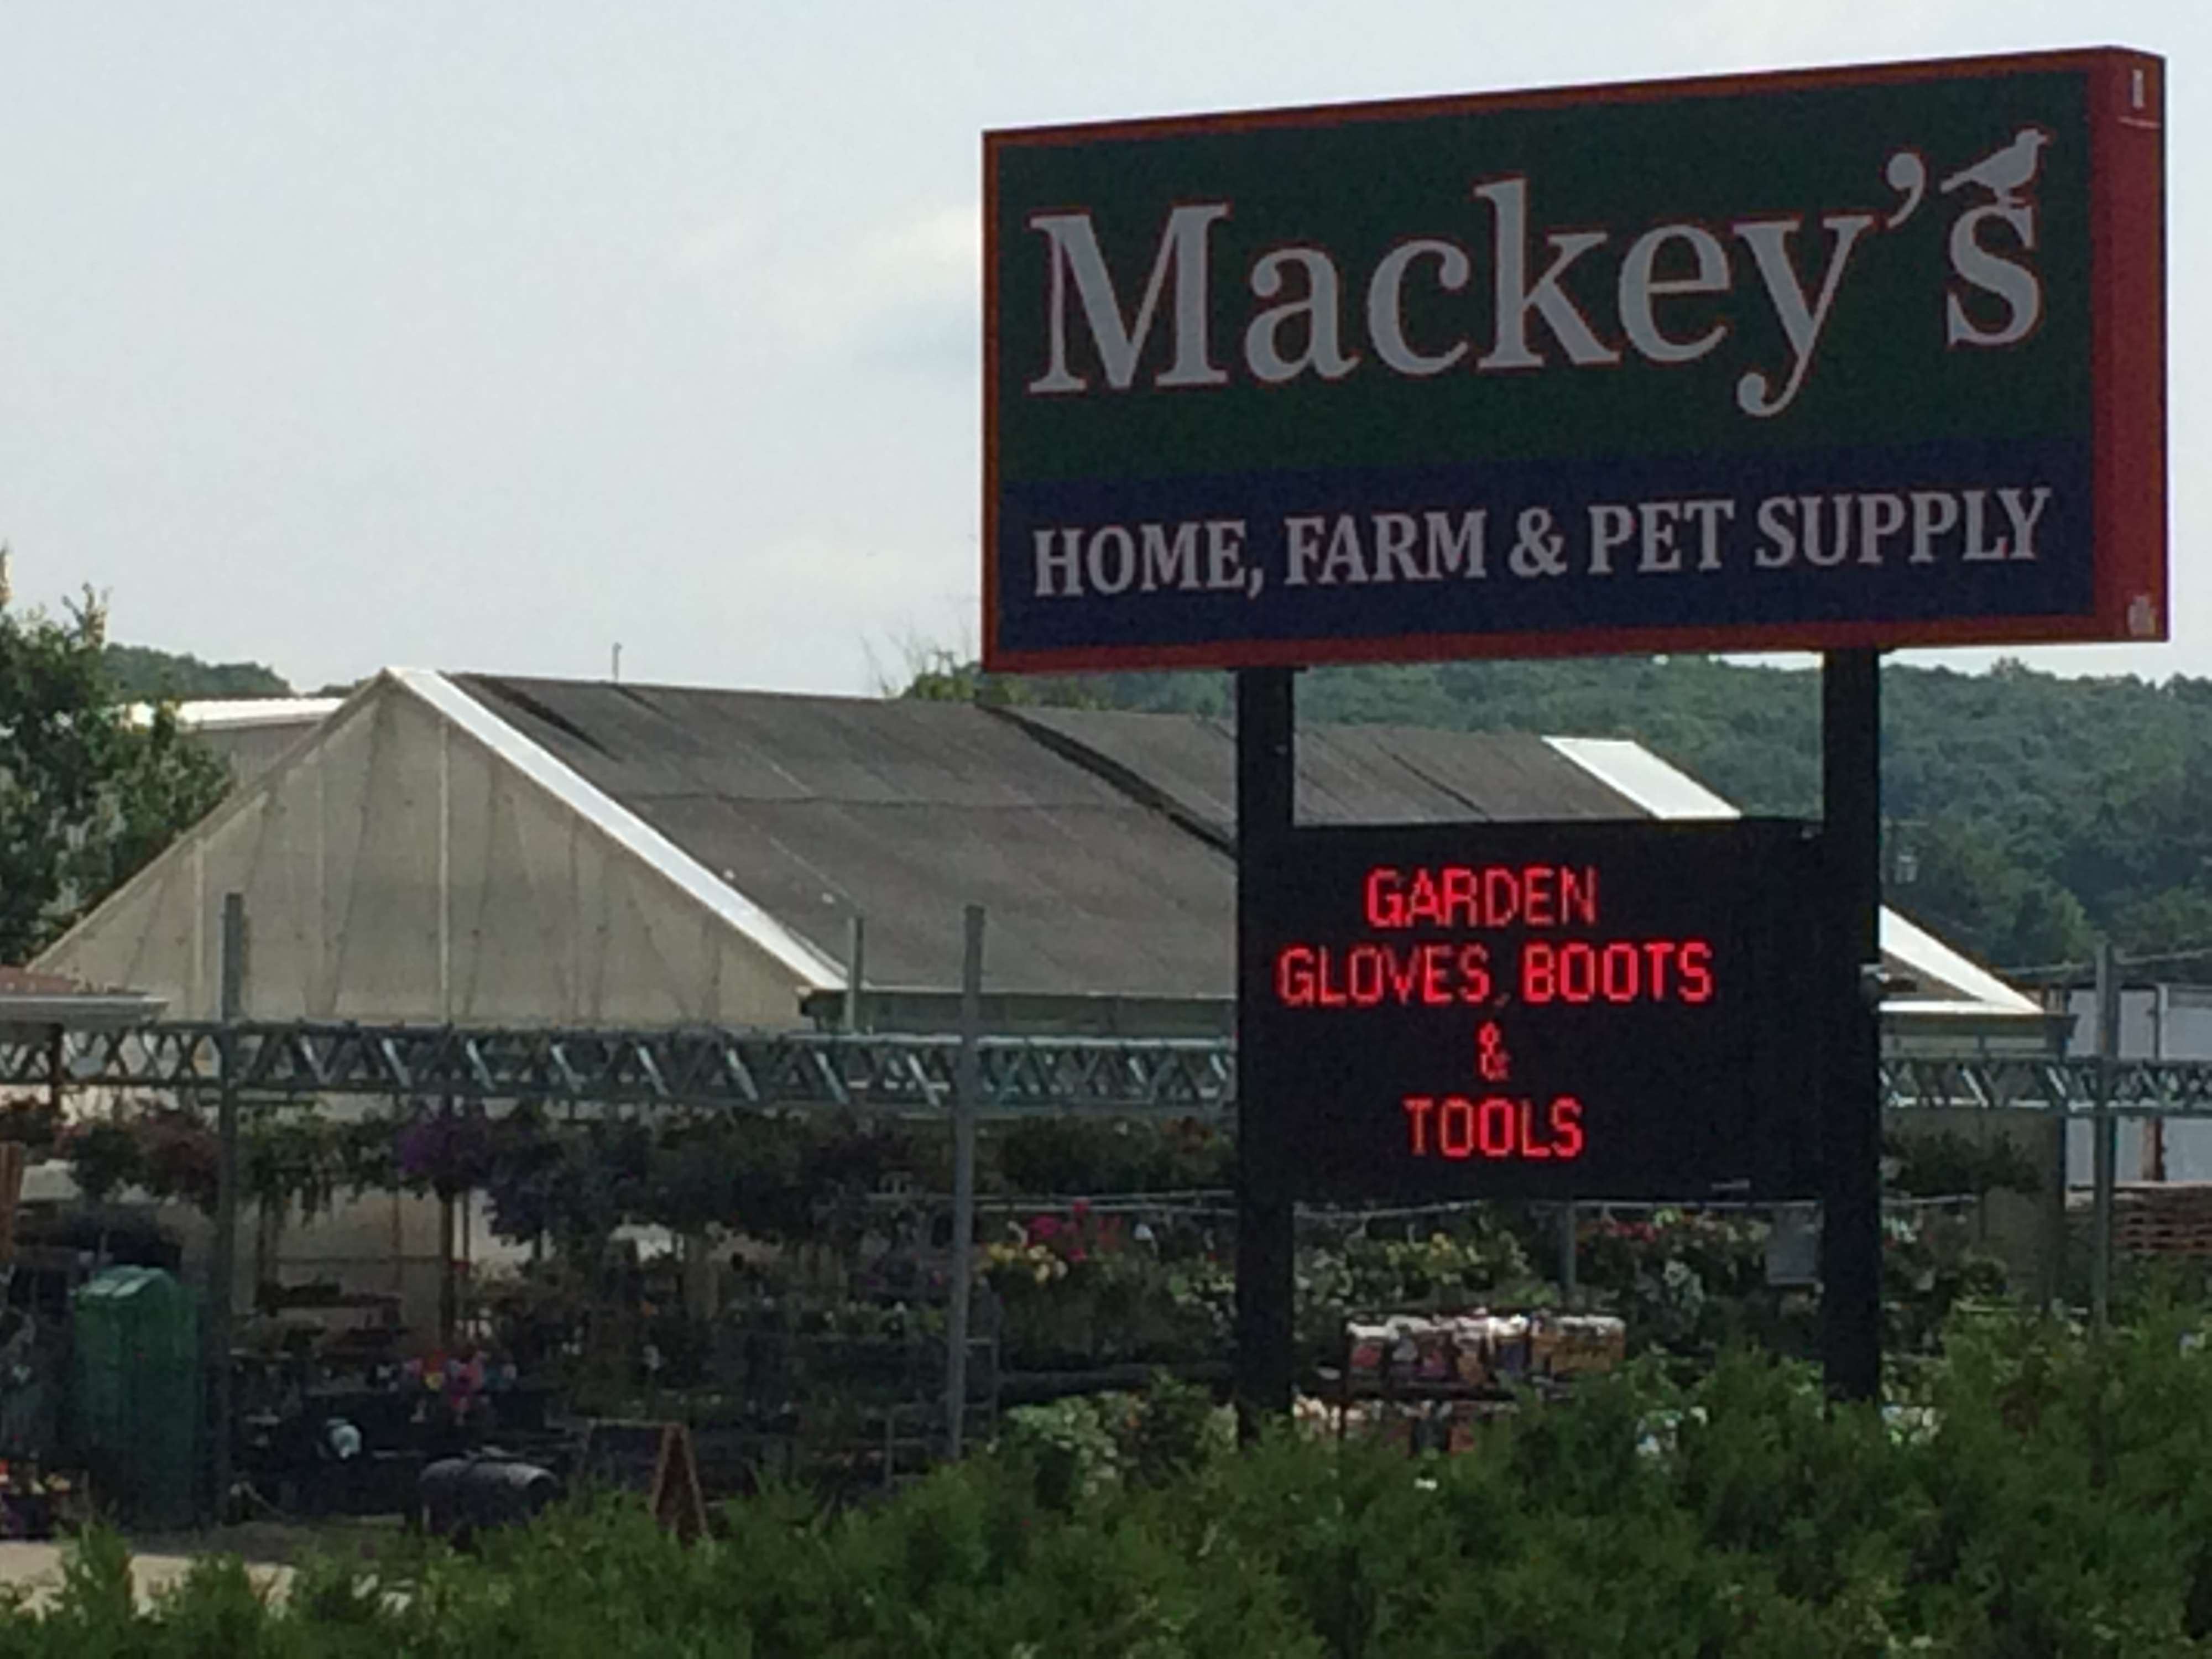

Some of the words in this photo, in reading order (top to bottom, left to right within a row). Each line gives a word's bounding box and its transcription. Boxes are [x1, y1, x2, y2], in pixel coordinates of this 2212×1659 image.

[1027, 149, 2042, 417] Mackey's
[1033, 521, 1263, 599] HOME,
[1284, 510, 1488, 585] FARM
[1509, 505, 1566, 577] &
[1589, 500, 1735, 573] PET
[1755, 488, 2051, 567] SUPPLY
[1366, 867, 1597, 927] GARDEN
[1523, 942, 1713, 1003] BOOTS
[1477, 1021, 1510, 1081] &
[1404, 1098, 1584, 1159] TOOLS
